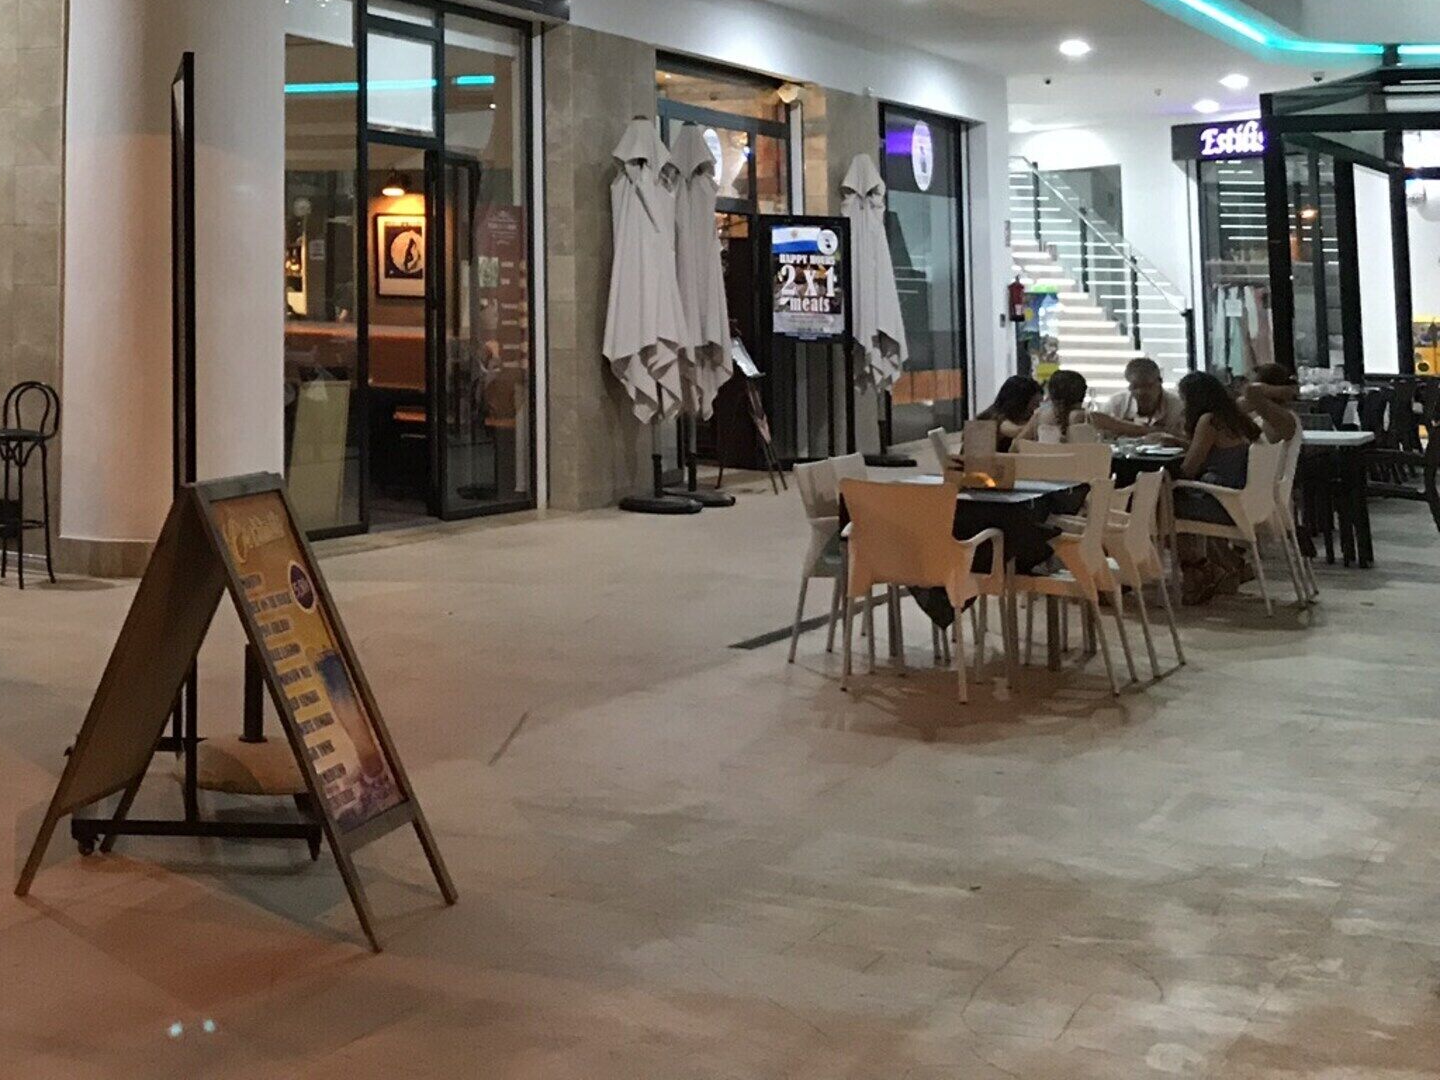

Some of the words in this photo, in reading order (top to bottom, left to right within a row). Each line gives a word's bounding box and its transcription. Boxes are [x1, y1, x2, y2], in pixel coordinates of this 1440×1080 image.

[780, 265, 796, 296] 2
[824, 266, 836, 297] 1
[789, 296, 831, 313] meats
